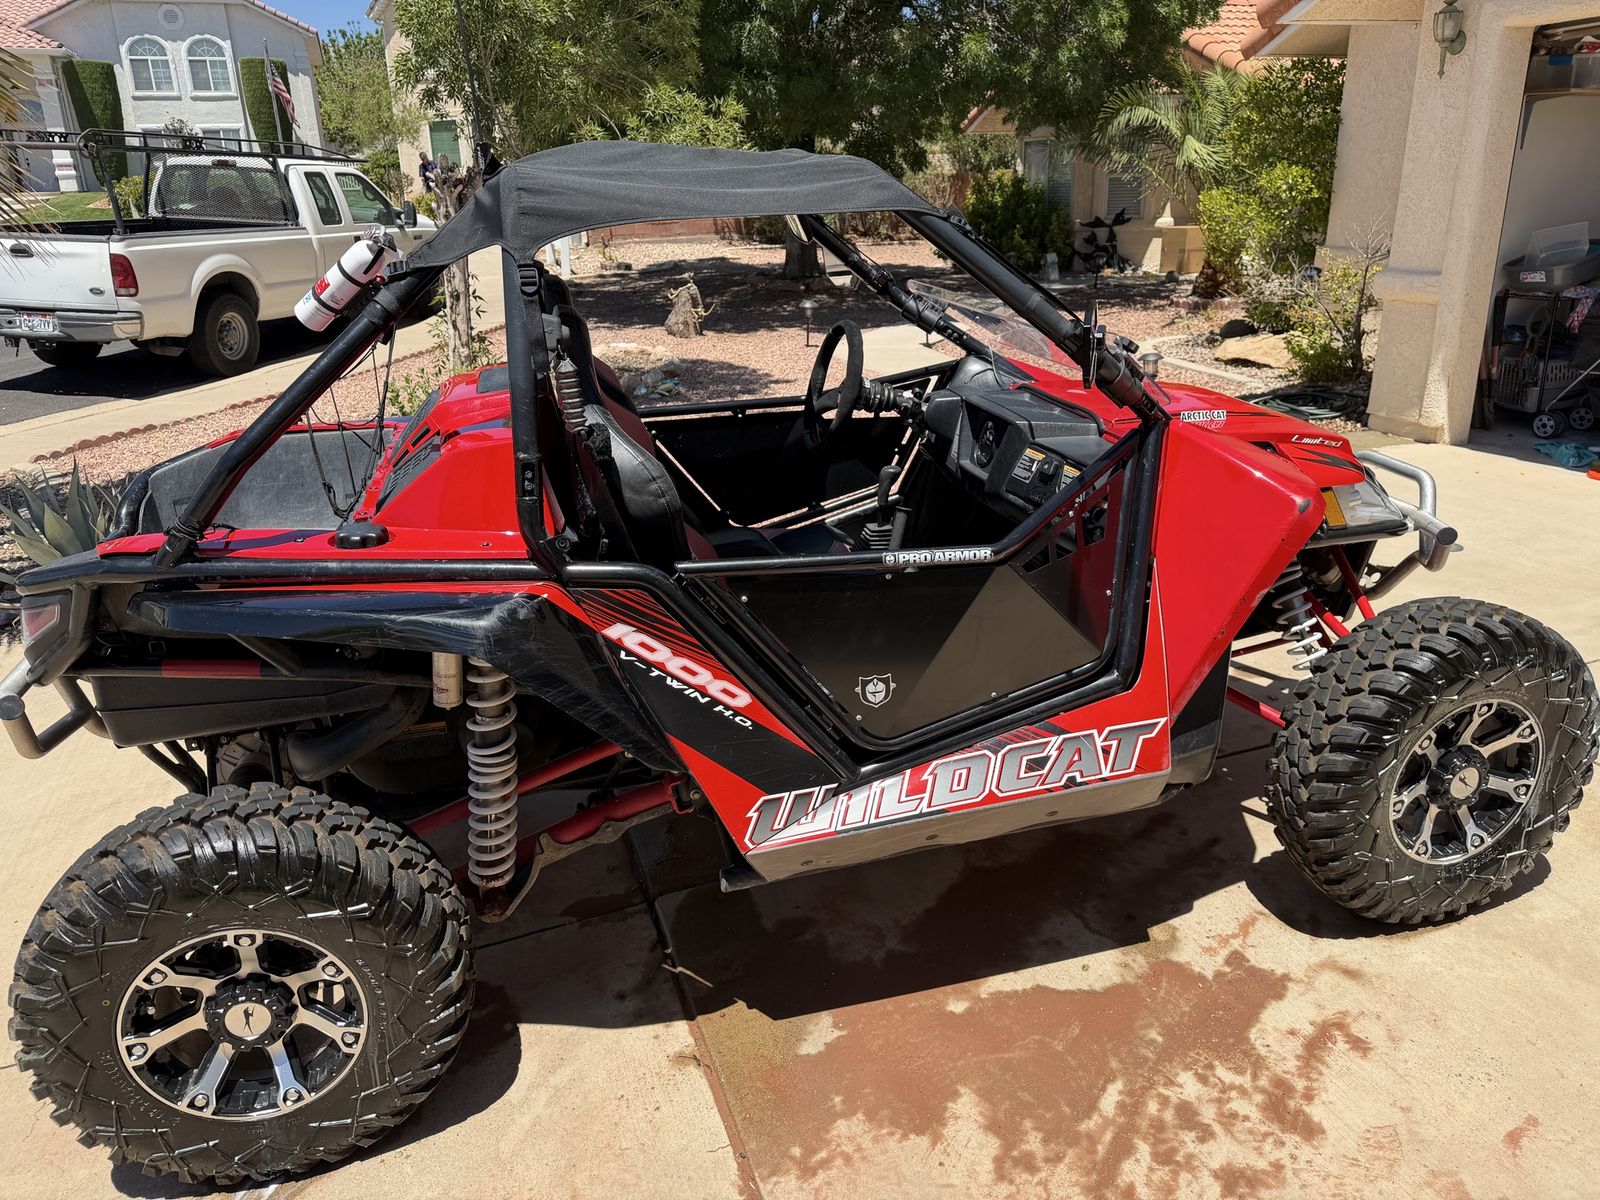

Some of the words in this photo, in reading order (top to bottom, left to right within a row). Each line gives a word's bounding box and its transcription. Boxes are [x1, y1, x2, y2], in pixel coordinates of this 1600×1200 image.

[1181, 411, 1210, 421] ARCTIC
[1211, 410, 1226, 420] CAT
[1291, 434, 1343, 447] Limited
[898, 551, 932, 564] PRO
[934, 548, 992, 562] ARMOR
[601, 623, 752, 708] 1000
[713, 705, 753, 729] H.O.
[743, 717, 1168, 849] WILDCAT
